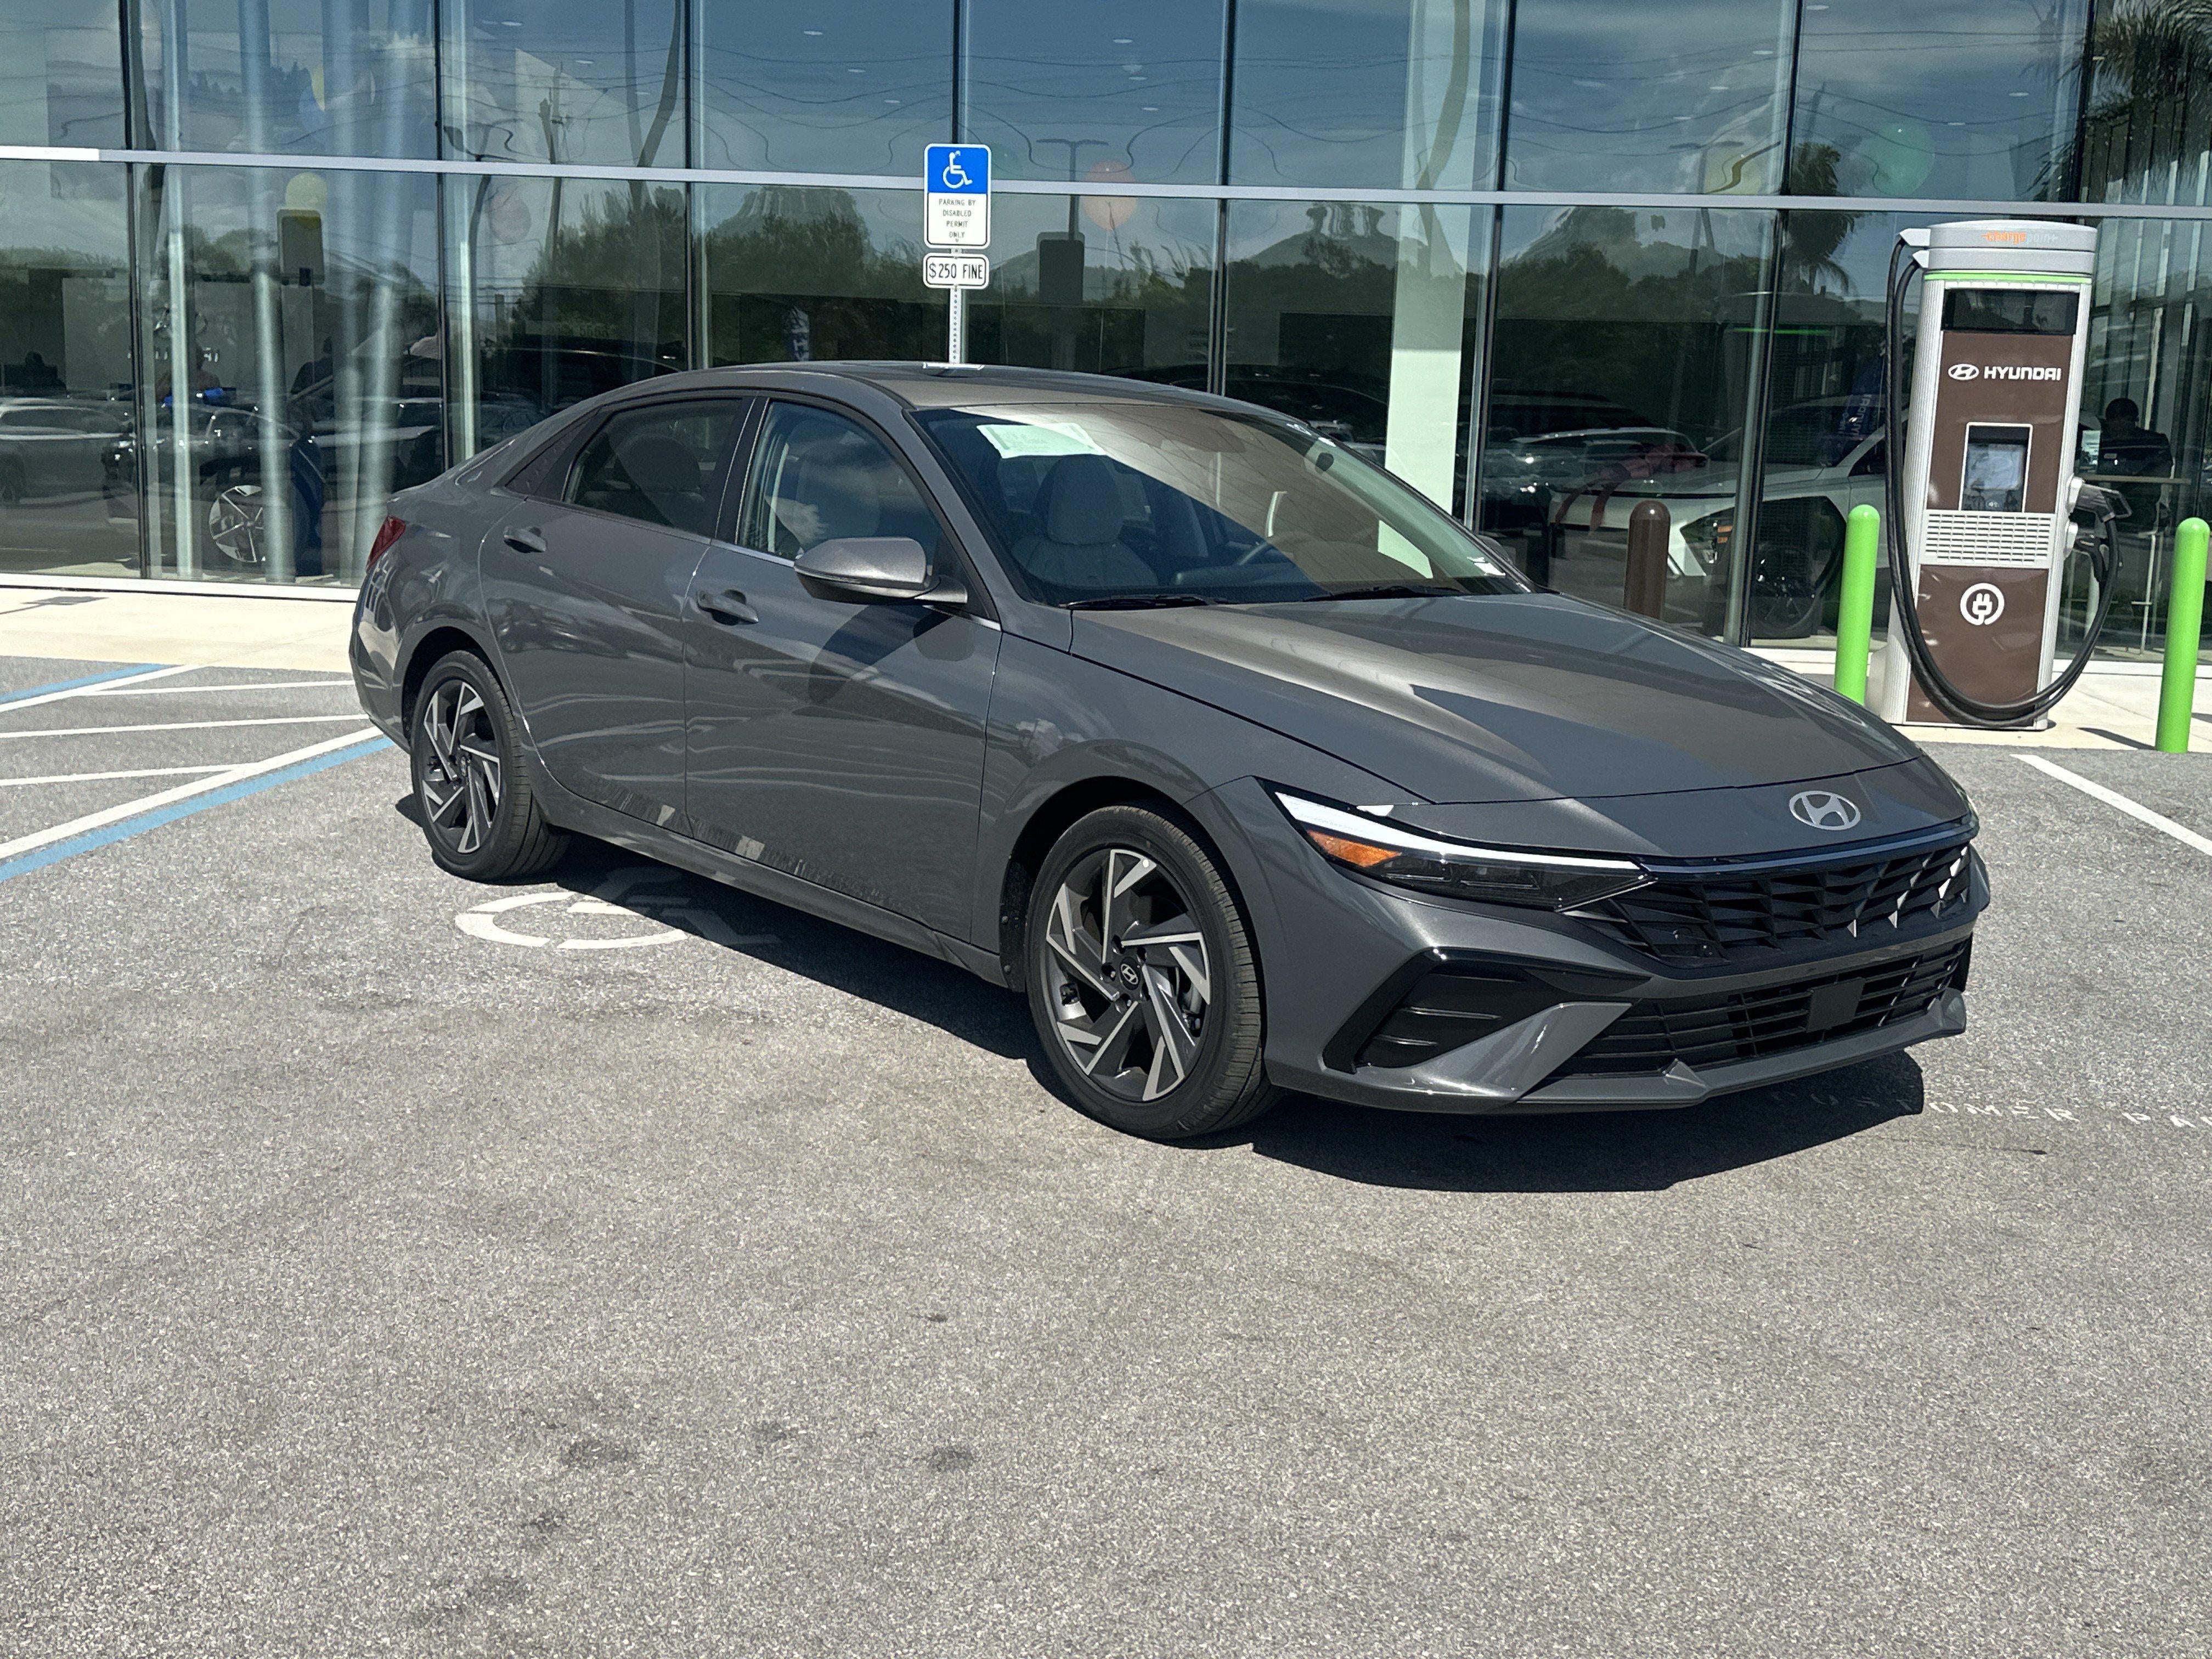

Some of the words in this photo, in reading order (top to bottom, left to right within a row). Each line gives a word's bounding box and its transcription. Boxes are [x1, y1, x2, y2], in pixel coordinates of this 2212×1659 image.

[929, 262, 957, 279] $250
[962, 264, 983, 279] FINE
[1984, 366, 2062, 381] HYUNDAI
